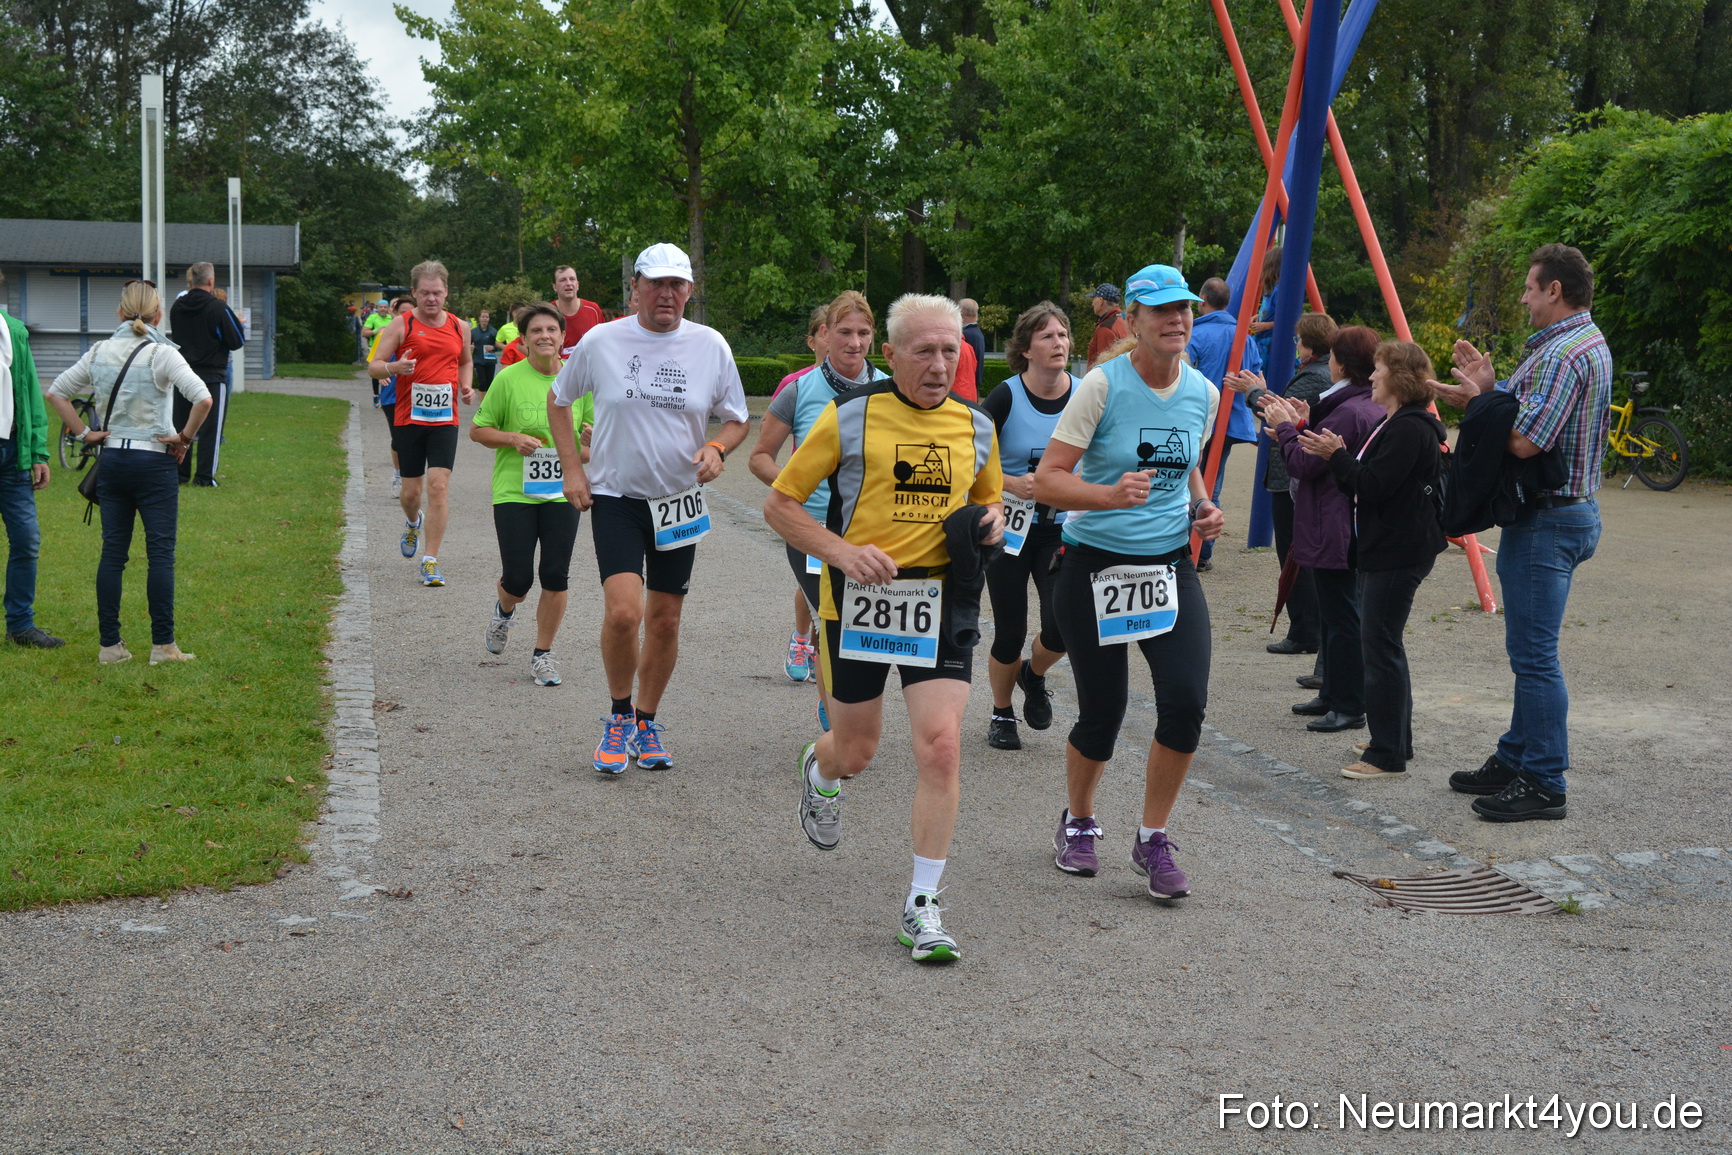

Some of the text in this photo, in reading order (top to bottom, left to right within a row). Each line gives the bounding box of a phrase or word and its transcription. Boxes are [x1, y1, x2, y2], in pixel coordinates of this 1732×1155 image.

[416, 392, 449, 407] 2942
[640, 392, 686, 404] Neumarkter
[651, 401, 686, 411] Stadtlauf
[894, 493, 950, 508] HIRSCH
[658, 491, 702, 527] 2706
[672, 524, 700, 540] Werner
[1093, 569, 1164, 584] PARTL Neumarkt
[847, 581, 924, 597] PARTL Neumarkt
[1103, 579, 1169, 615] 2703
[852, 596, 931, 633] 2816
[1126, 619, 1151, 631] Petra
[860, 635, 918, 656] Wolfgang
